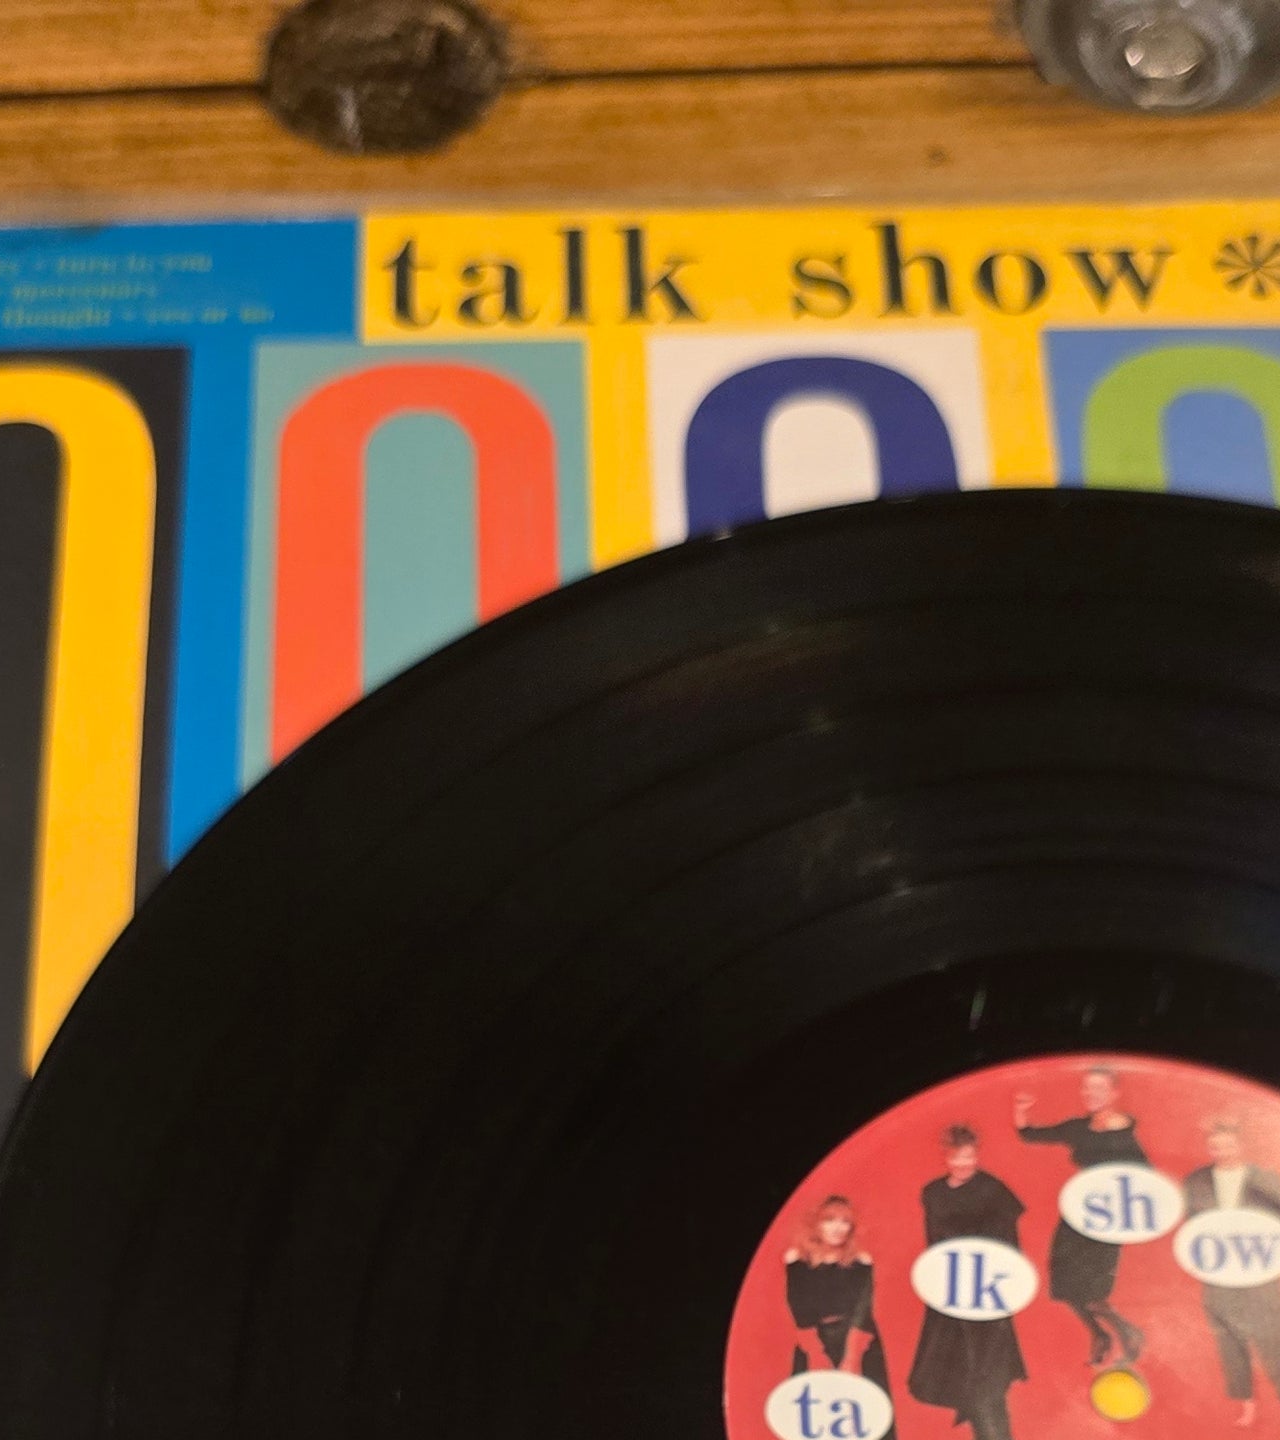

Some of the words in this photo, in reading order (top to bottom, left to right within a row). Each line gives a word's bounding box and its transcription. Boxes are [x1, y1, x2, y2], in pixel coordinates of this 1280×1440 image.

[381, 226, 708, 328] talk
[790, 222, 1174, 319] show
[794, 1386, 869, 1440] ta
[943, 1250, 1010, 1312] lk
[1082, 1175, 1157, 1232] sh
